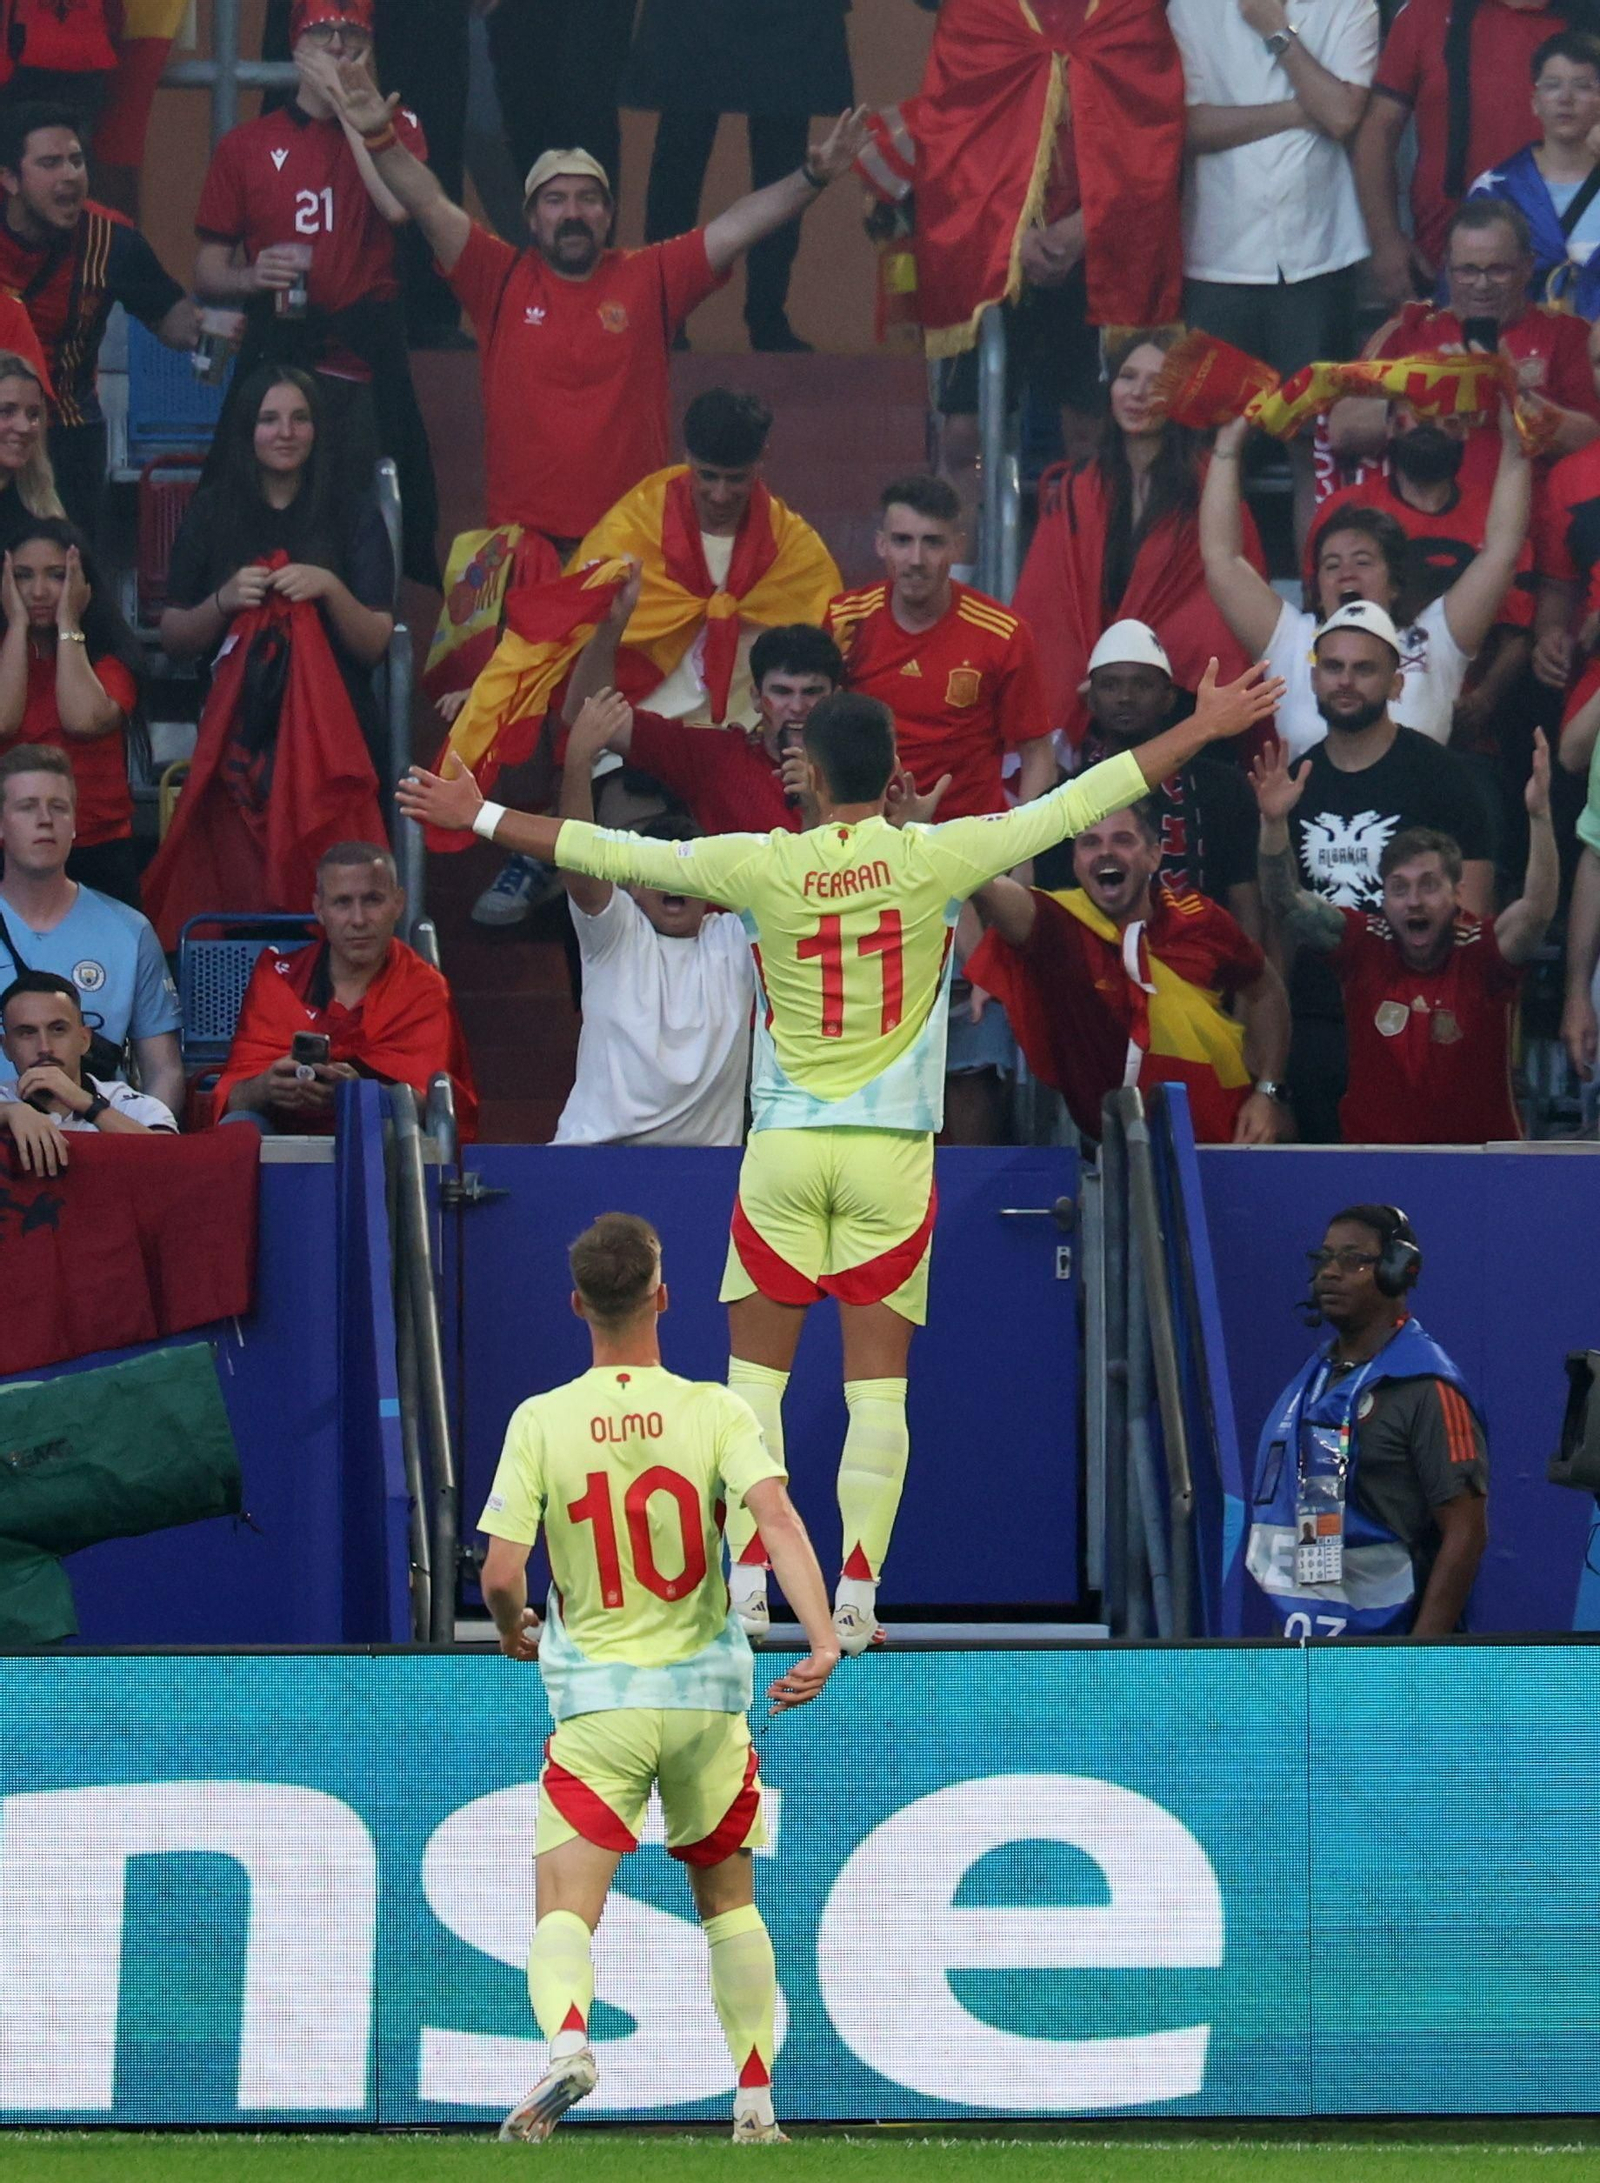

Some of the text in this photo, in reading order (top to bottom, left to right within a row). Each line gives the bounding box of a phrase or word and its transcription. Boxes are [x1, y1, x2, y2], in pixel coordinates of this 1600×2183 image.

[295, 187, 334, 235] 21
[804, 860, 891, 898] FERRAN
[796, 909, 904, 1038] 11
[590, 1412, 663, 1443] OLMO
[567, 1465, 707, 1609] 10
